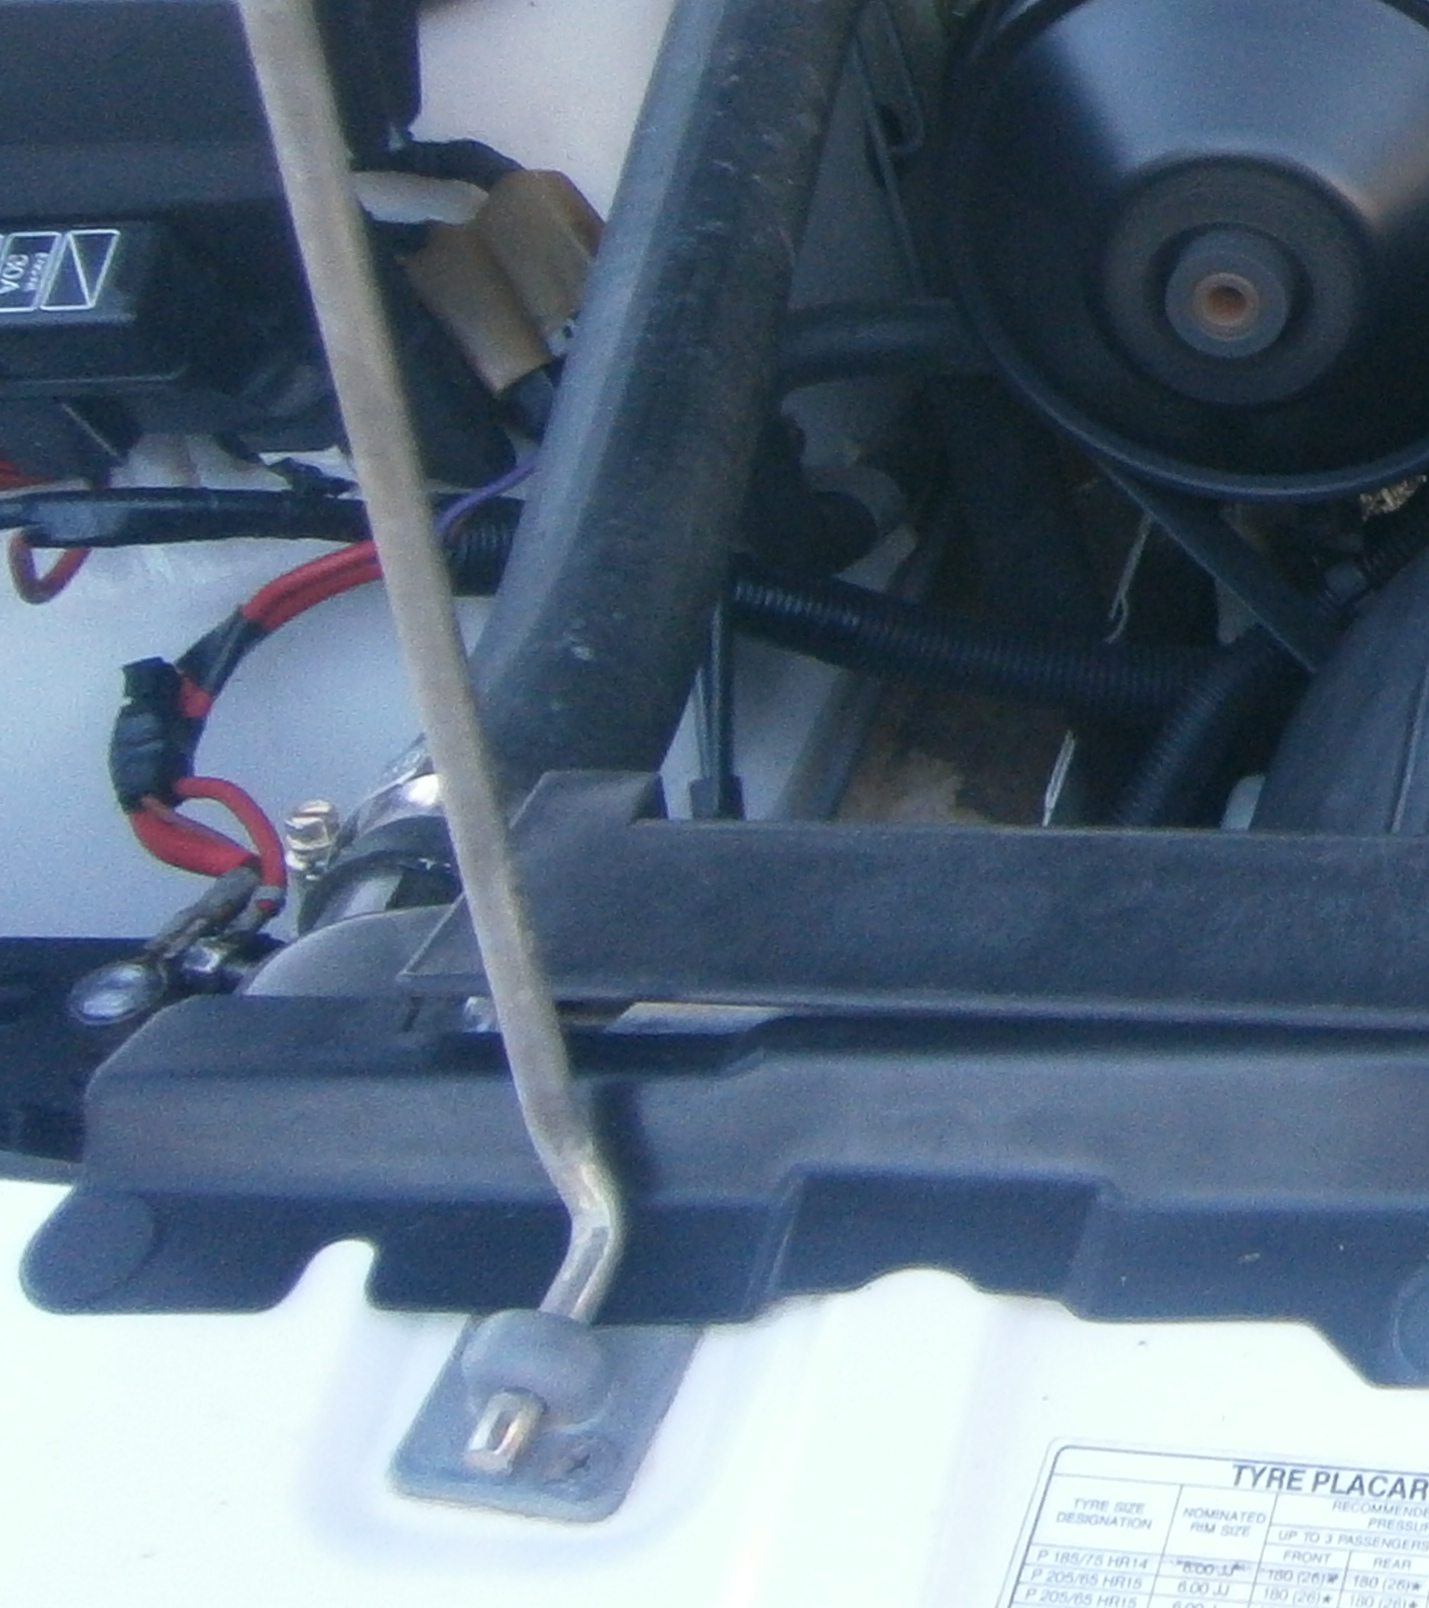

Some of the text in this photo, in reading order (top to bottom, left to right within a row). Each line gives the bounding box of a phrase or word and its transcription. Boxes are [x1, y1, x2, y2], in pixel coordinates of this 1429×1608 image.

[1232, 1464, 1306, 1491] TYRE
[1073, 1497, 1146, 1515] TYRE SIZE
[1056, 1511, 1153, 1531] DESIGNATION
[1182, 1506, 1267, 1525] NOMINATED
[1277, 1529, 1298, 1542] UP
[1303, 1530, 1320, 1544] TO
[1282, 1550, 1332, 1565] FRONT
